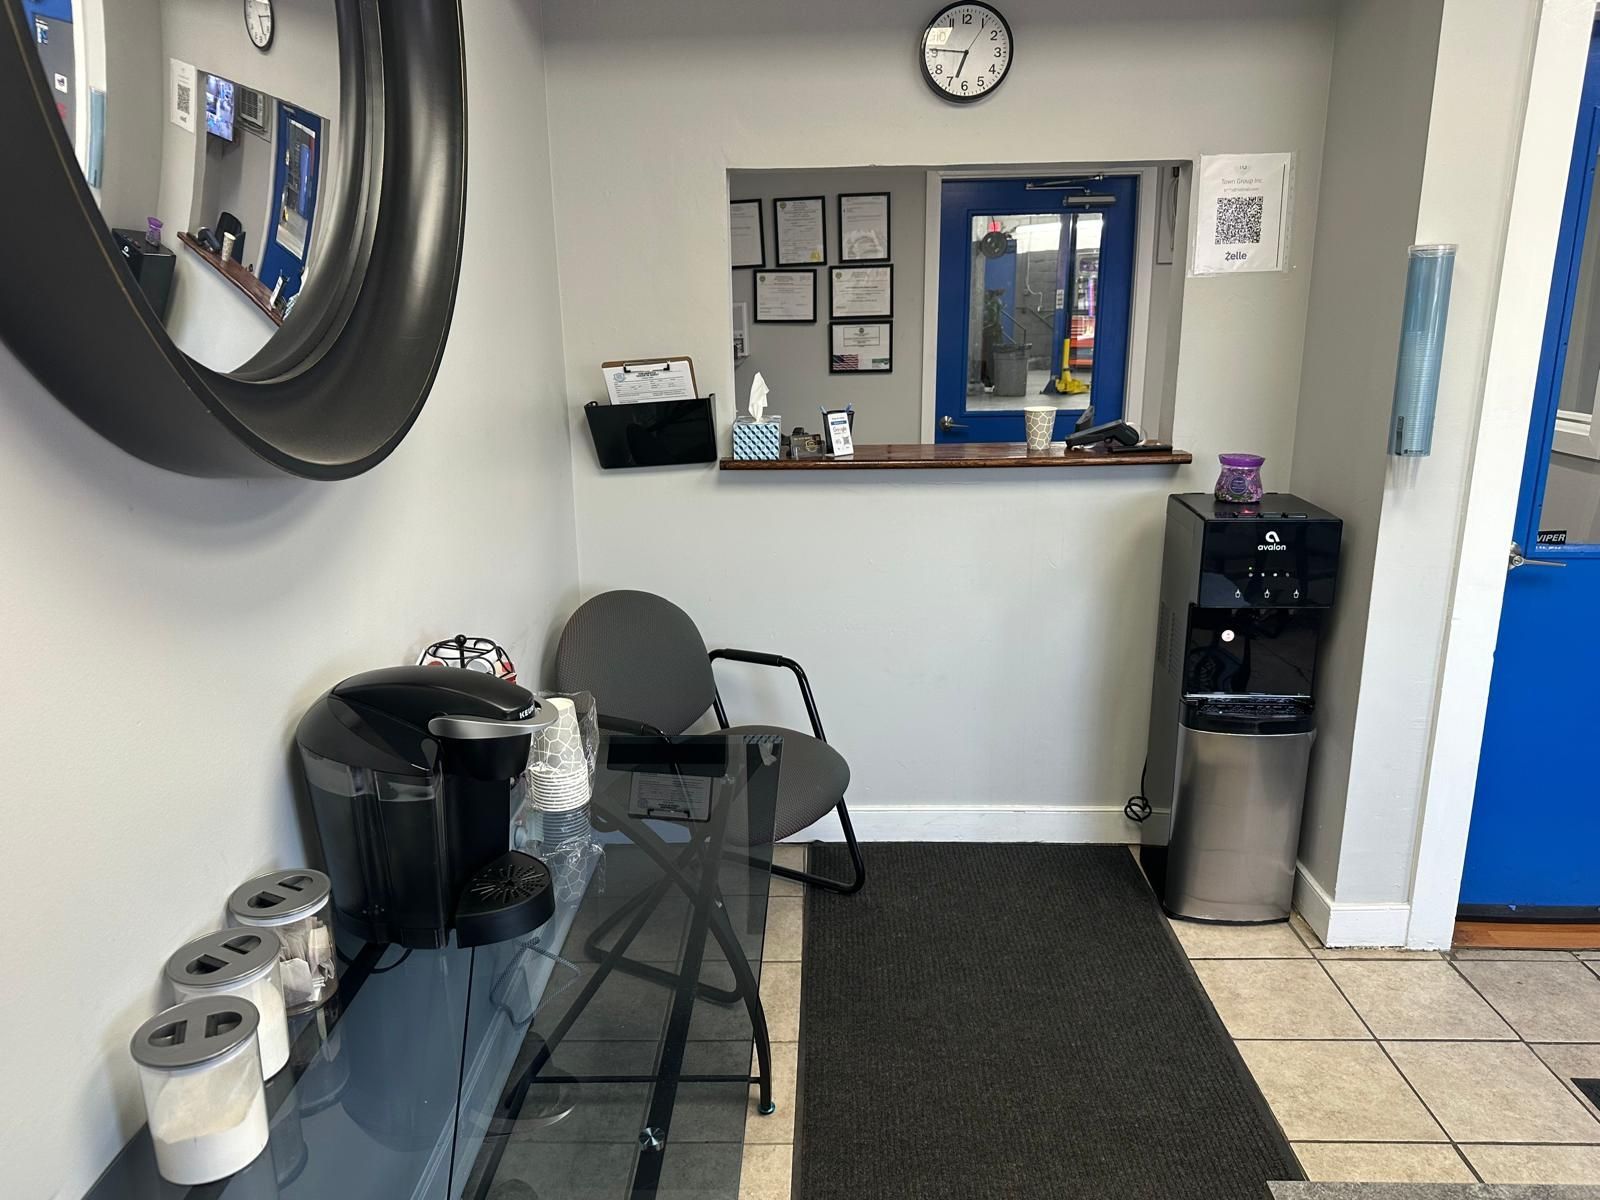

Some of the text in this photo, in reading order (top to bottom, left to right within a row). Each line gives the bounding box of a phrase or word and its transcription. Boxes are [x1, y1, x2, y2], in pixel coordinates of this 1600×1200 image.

[962, 13, 972, 25] 12
[990, 30, 998, 41] 2
[931, 48, 938, 58] 9
[993, 47, 1002, 58] 3
[934, 64, 943, 75] 8
[988, 64, 996, 75] 4
[946, 76, 954, 87] 7
[960, 81, 969, 91] 6
[976, 76, 985, 87] 5
[1225, 251, 1247, 261] Zelle
[1536, 533, 1566, 542] VIPER
[1257, 542, 1286, 551] avalon
